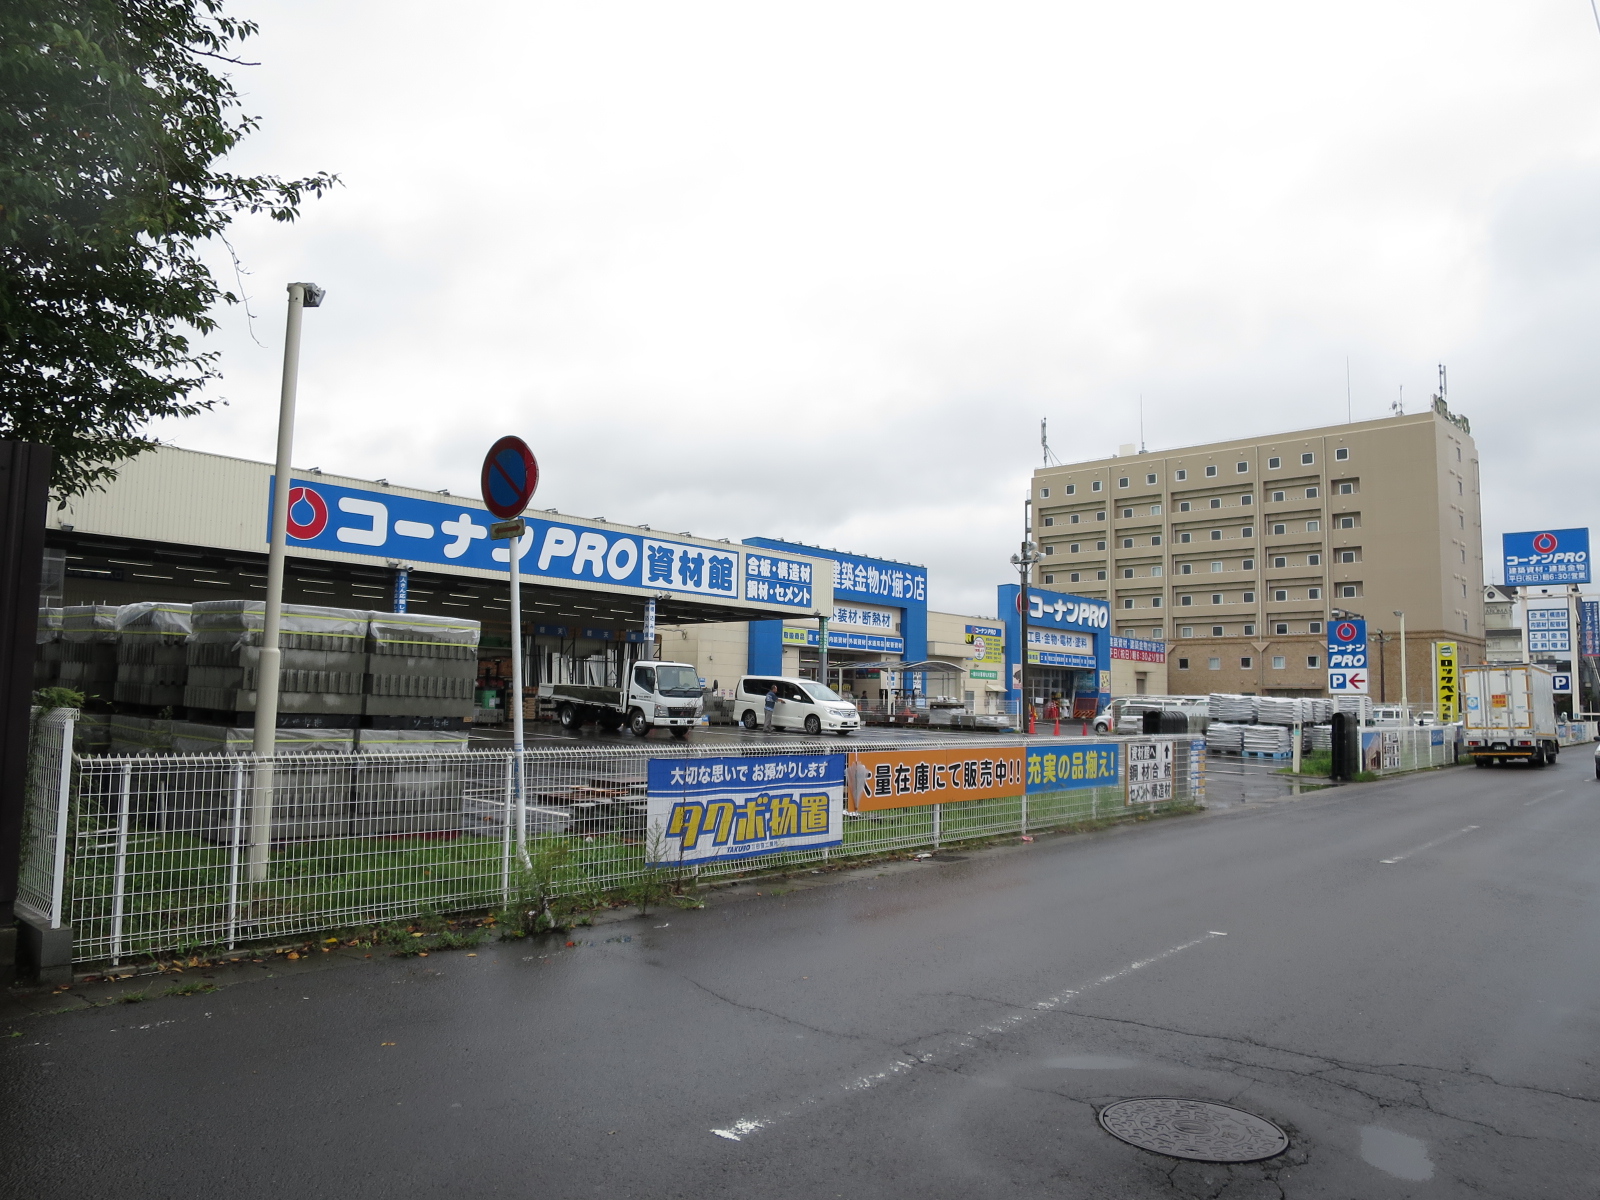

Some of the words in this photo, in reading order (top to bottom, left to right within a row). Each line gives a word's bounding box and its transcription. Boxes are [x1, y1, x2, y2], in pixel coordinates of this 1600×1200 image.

[647, 545, 733, 592] 資材館
[746, 556, 811, 583] 合板・構造材
[1506, 551, 1587, 566] コーナンPRO
[746, 579, 811, 605] 鋼材・セメント
[1029, 595, 1109, 629] コーナンPRO
[1328, 643, 1365, 653] コーナン
[1329, 654, 1365, 667] PRO
[1332, 674, 1344, 687] P
[1555, 677, 1567, 689] P
[669, 763, 749, 786] 大切な思いで
[752, 761, 829, 782] お預かりします
[1027, 750, 1116, 785] 充実の品揃え!
[666, 793, 829, 849] タクボ物置
